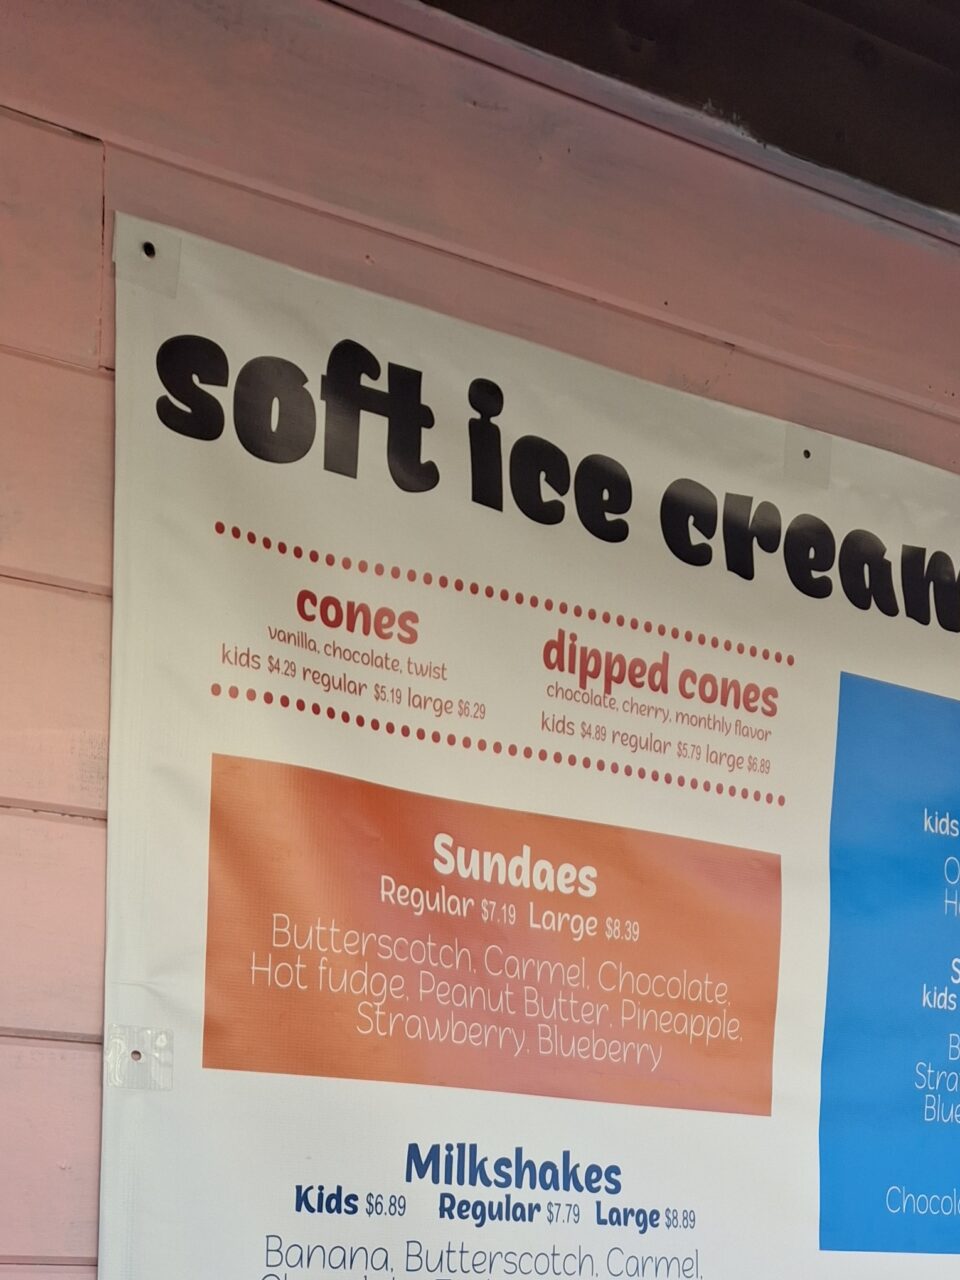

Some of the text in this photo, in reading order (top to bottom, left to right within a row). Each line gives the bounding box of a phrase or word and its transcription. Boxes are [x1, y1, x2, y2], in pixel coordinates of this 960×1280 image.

[155, 334, 440, 493] soft
[468, 378, 632, 543] ice
[297, 589, 419, 644] cones
[221, 643, 486, 720] kids $4.29 regular $5.19 large $6.29
[268, 626, 448, 681] vanilla, chocolate, twist
[543, 628, 779, 717] dipped cones
[541, 711, 771, 775] kids $4.89 regular $5.79 large $6.89
[675, 710, 772, 741] monthly flavor
[924, 808, 959, 837] kids
[433, 833, 597, 898] Sundaes
[380, 875, 639, 943] Regular $7.19 Large $8.39
[251, 952, 307, 991] Hot
[419, 970, 515, 1014] Peanut
[271, 913, 731, 1006] Butterscotch, Chocolate,
[922, 984, 957, 1010] kids
[357, 1001, 662, 1072] Strawberry, Blueberry
[405, 1143, 622, 1195] Milkshakes
[295, 1184, 696, 1234] Kids $6.89 Regular $7.79 Large $8.89
[265, 1235, 703, 1280] Banana, Butterscotch, Carmel,
